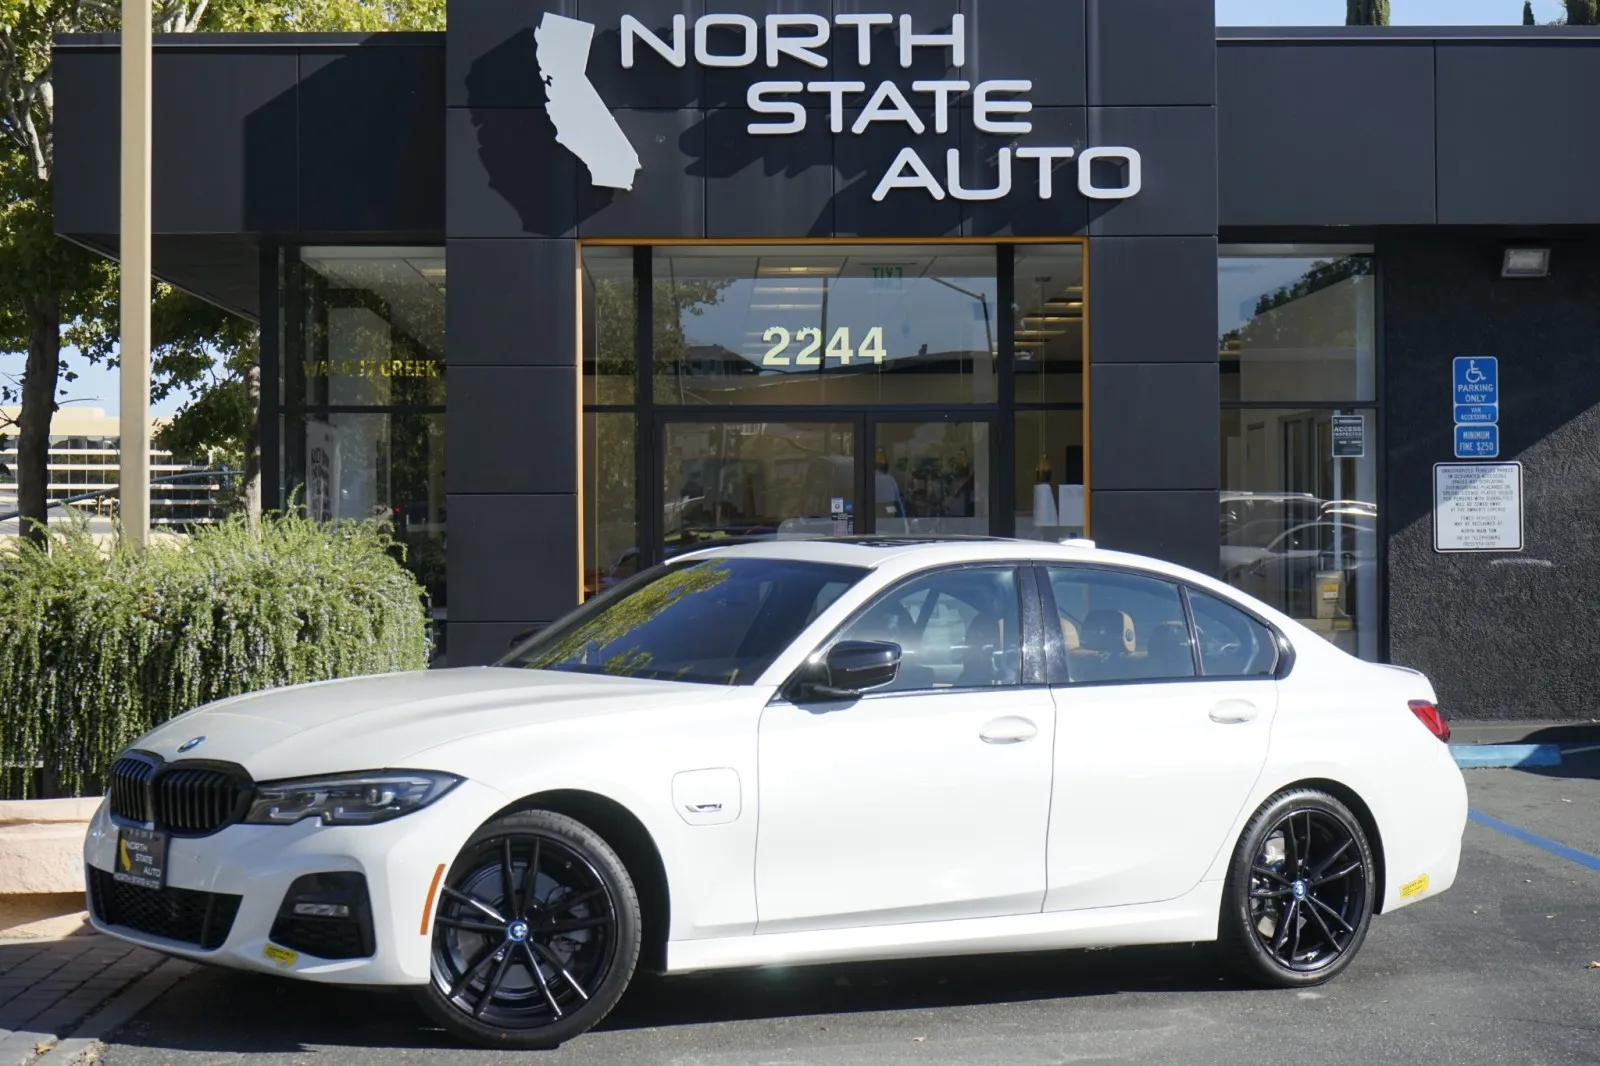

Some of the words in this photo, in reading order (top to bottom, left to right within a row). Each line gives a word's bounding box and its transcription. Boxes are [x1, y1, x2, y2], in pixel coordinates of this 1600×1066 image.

[620, 14, 965, 69] NORTH
[746, 79, 1033, 134] STATE
[871, 146, 1142, 201] AUTO
[762, 326, 887, 366] 2244
[379, 359, 438, 378] CREEK
[1458, 384, 1494, 392] PARKING
[1465, 394, 1487, 402] ONLY
[1463, 431, 1490, 440] MINIMUM
[1459, 442, 1474, 451] FINE
[1476, 441, 1494, 451] $250
[126, 841, 148, 852] NORTH
[135, 853, 153, 865] STATE
[143, 866, 161, 877] AUTO
